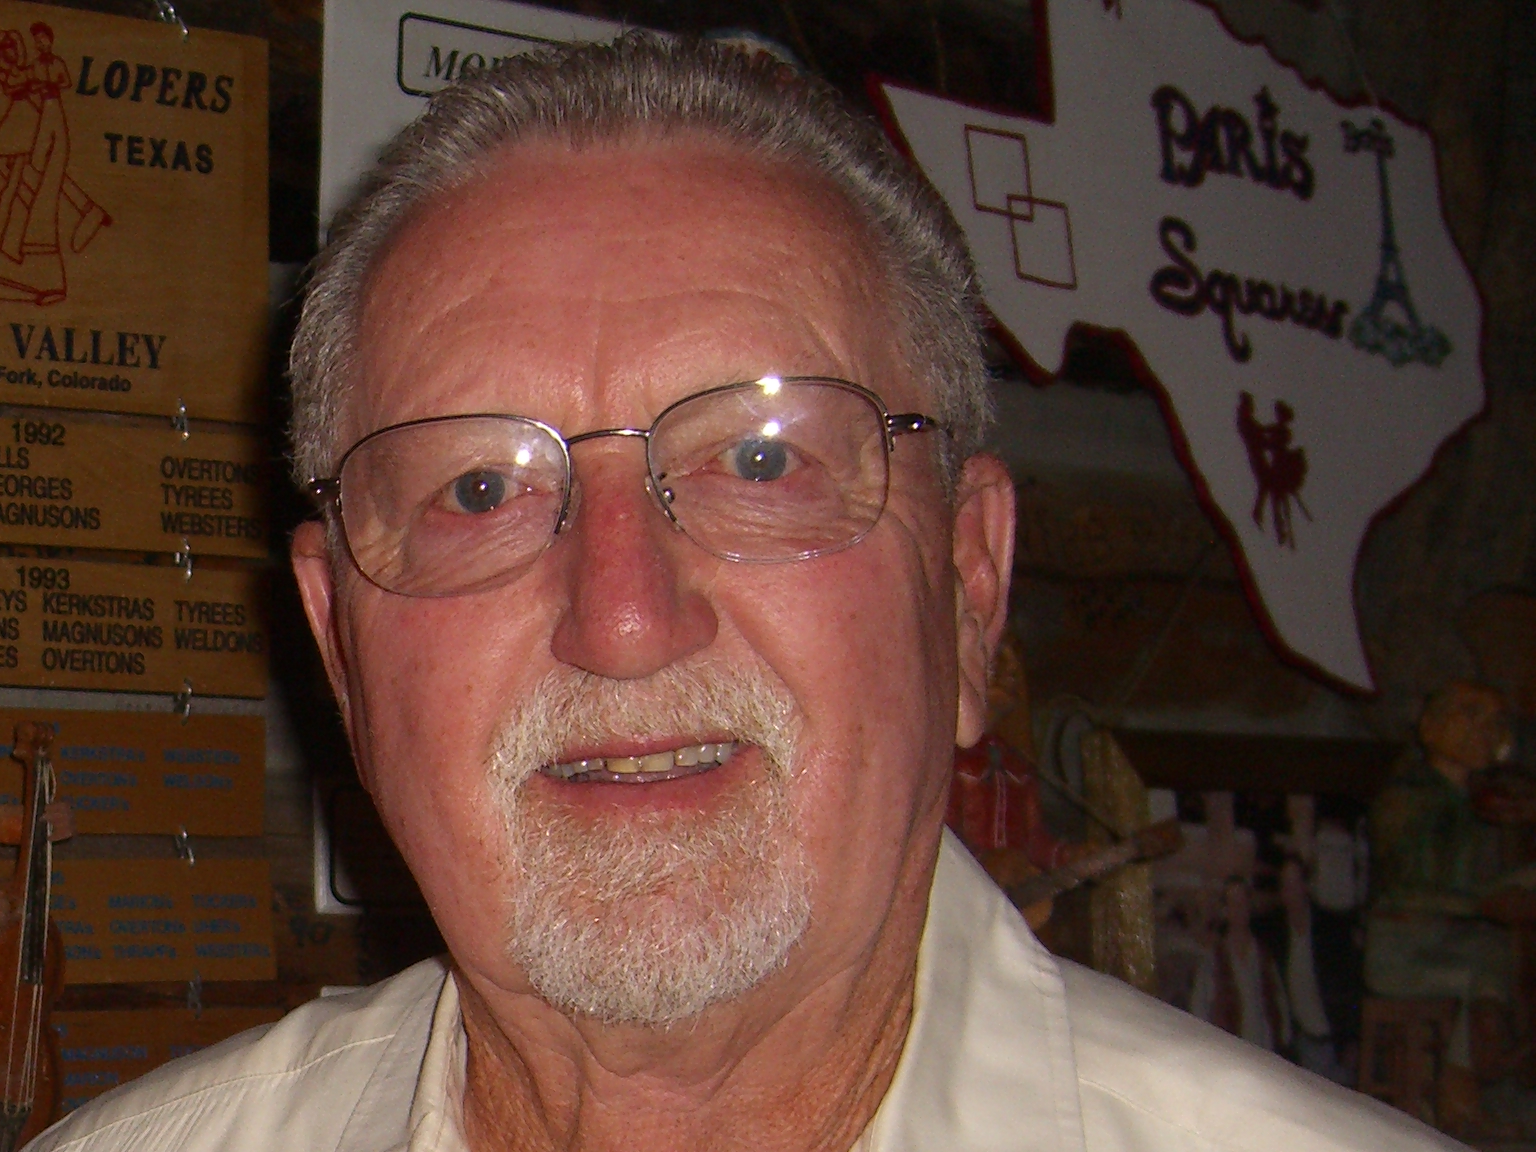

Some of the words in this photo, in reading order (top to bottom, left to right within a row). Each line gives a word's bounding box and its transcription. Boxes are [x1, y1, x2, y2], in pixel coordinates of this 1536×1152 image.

[76, 55, 234, 114] LOPERS
[104, 132, 213, 174] TEXAS
[10, 322, 167, 369] VALLEY
[47, 369, 132, 392] Colorado
[12, 421, 66, 445] 1992
[161, 456, 259, 484] OVERTONS
[161, 484, 233, 510] TYREES
[161, 512, 262, 539] WEBSTERS
[17, 566, 70, 590] 1993
[42, 592, 154, 620] KERKSTRAS
[174, 600, 246, 626] TYREES
[42, 620, 163, 649] MAGNUSONS
[174, 628, 263, 653] WELDONS
[42, 648, 145, 675] OVERTONS
